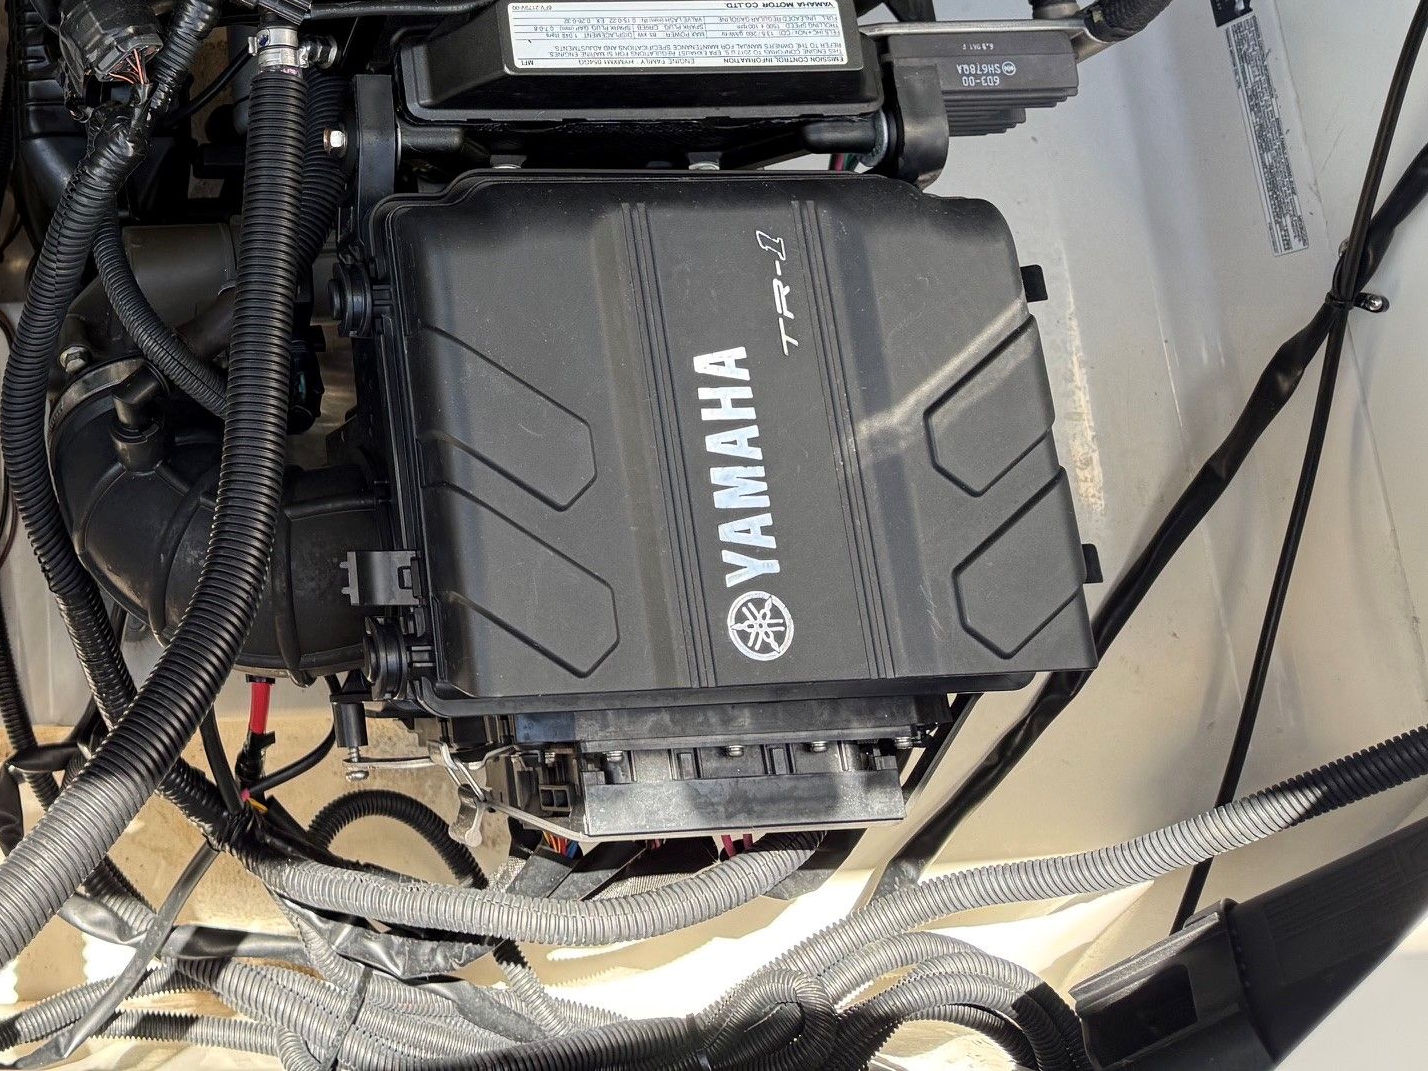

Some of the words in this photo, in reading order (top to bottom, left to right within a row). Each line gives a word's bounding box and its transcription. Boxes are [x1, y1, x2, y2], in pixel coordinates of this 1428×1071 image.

[956, 64, 1001, 74] SH678QA
[962, 76, 1000, 86] 6D3-00
[756, 230, 799, 356] TR-1
[693, 346, 781, 588] YAMAHA
